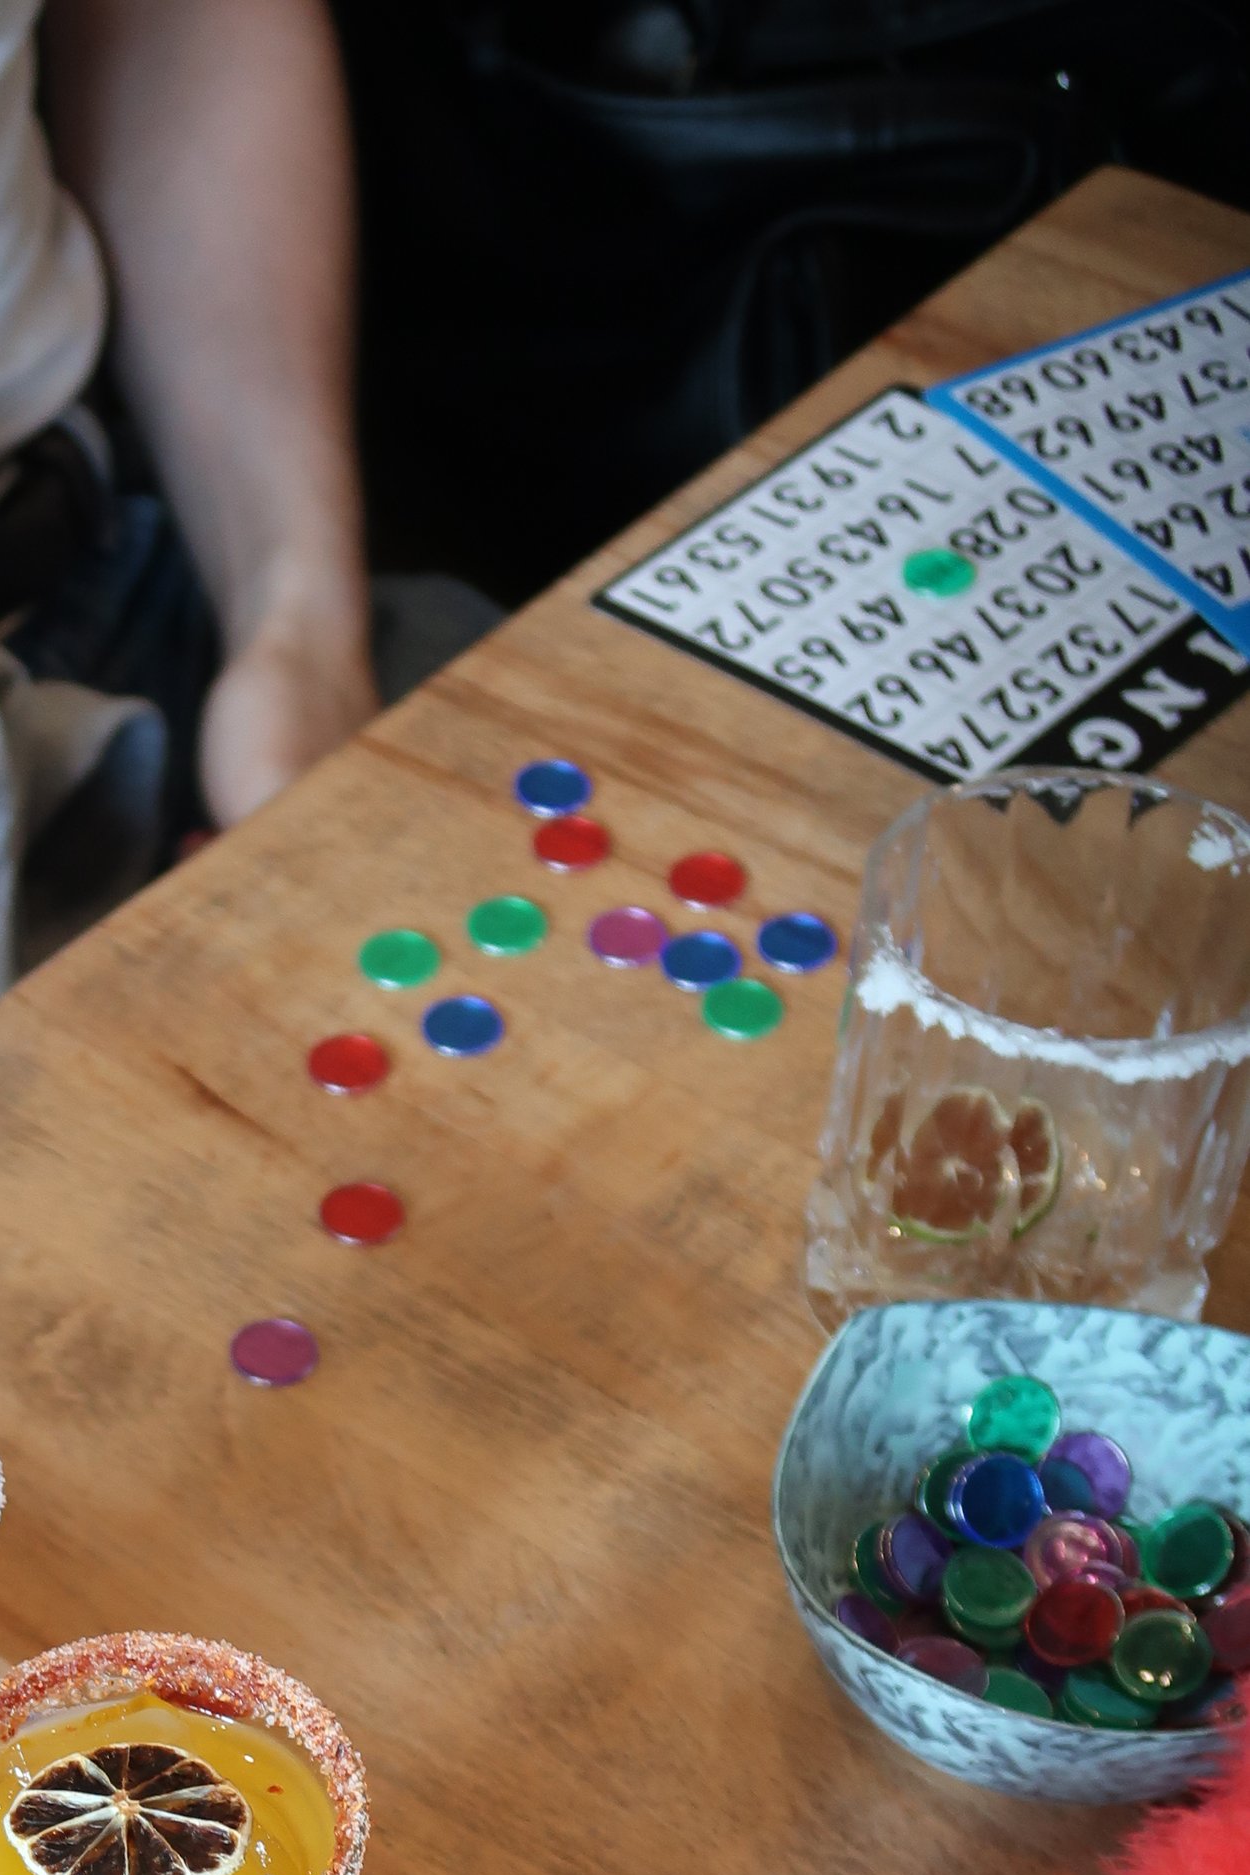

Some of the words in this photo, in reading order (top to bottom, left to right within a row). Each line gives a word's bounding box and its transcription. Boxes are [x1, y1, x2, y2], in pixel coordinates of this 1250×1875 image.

[1110, 324, 1183, 364] 43
[1039, 347, 1112, 392] 60
[1179, 359, 1249, 408] 37
[965, 374, 1039, 418] 68
[1102, 391, 1167, 433] 49
[870, 407, 926, 443] 2
[1016, 415, 1095, 462] 62
[811, 446, 882, 491] 19
[953, 444, 998, 479] 7
[1149, 433, 1224, 476] 48
[875, 478, 954, 523] 16
[1081, 457, 1152, 503] 61
[1205, 475, 1250, 521] 2
[751, 483, 824, 529] 31
[1133, 502, 1211, 550] 64
[687, 526, 764, 573] 53
[817, 518, 890, 566] 43
[950, 507, 1028, 560] 28
[630, 566, 701, 614] 61
[757, 556, 837, 608] 50
[1021, 541, 1104, 596] 20
[695, 600, 781, 653] 72
[839, 594, 907, 645] 49
[975, 586, 1047, 644] 37
[1107, 584, 1180, 637] 17
[772, 637, 848, 692] 65
[907, 631, 982, 683] 46
[1037, 622, 1123, 677] 32
[847, 674, 925, 728] 62
[979, 667, 1063, 722] 52
[925, 713, 1007, 771] 74
